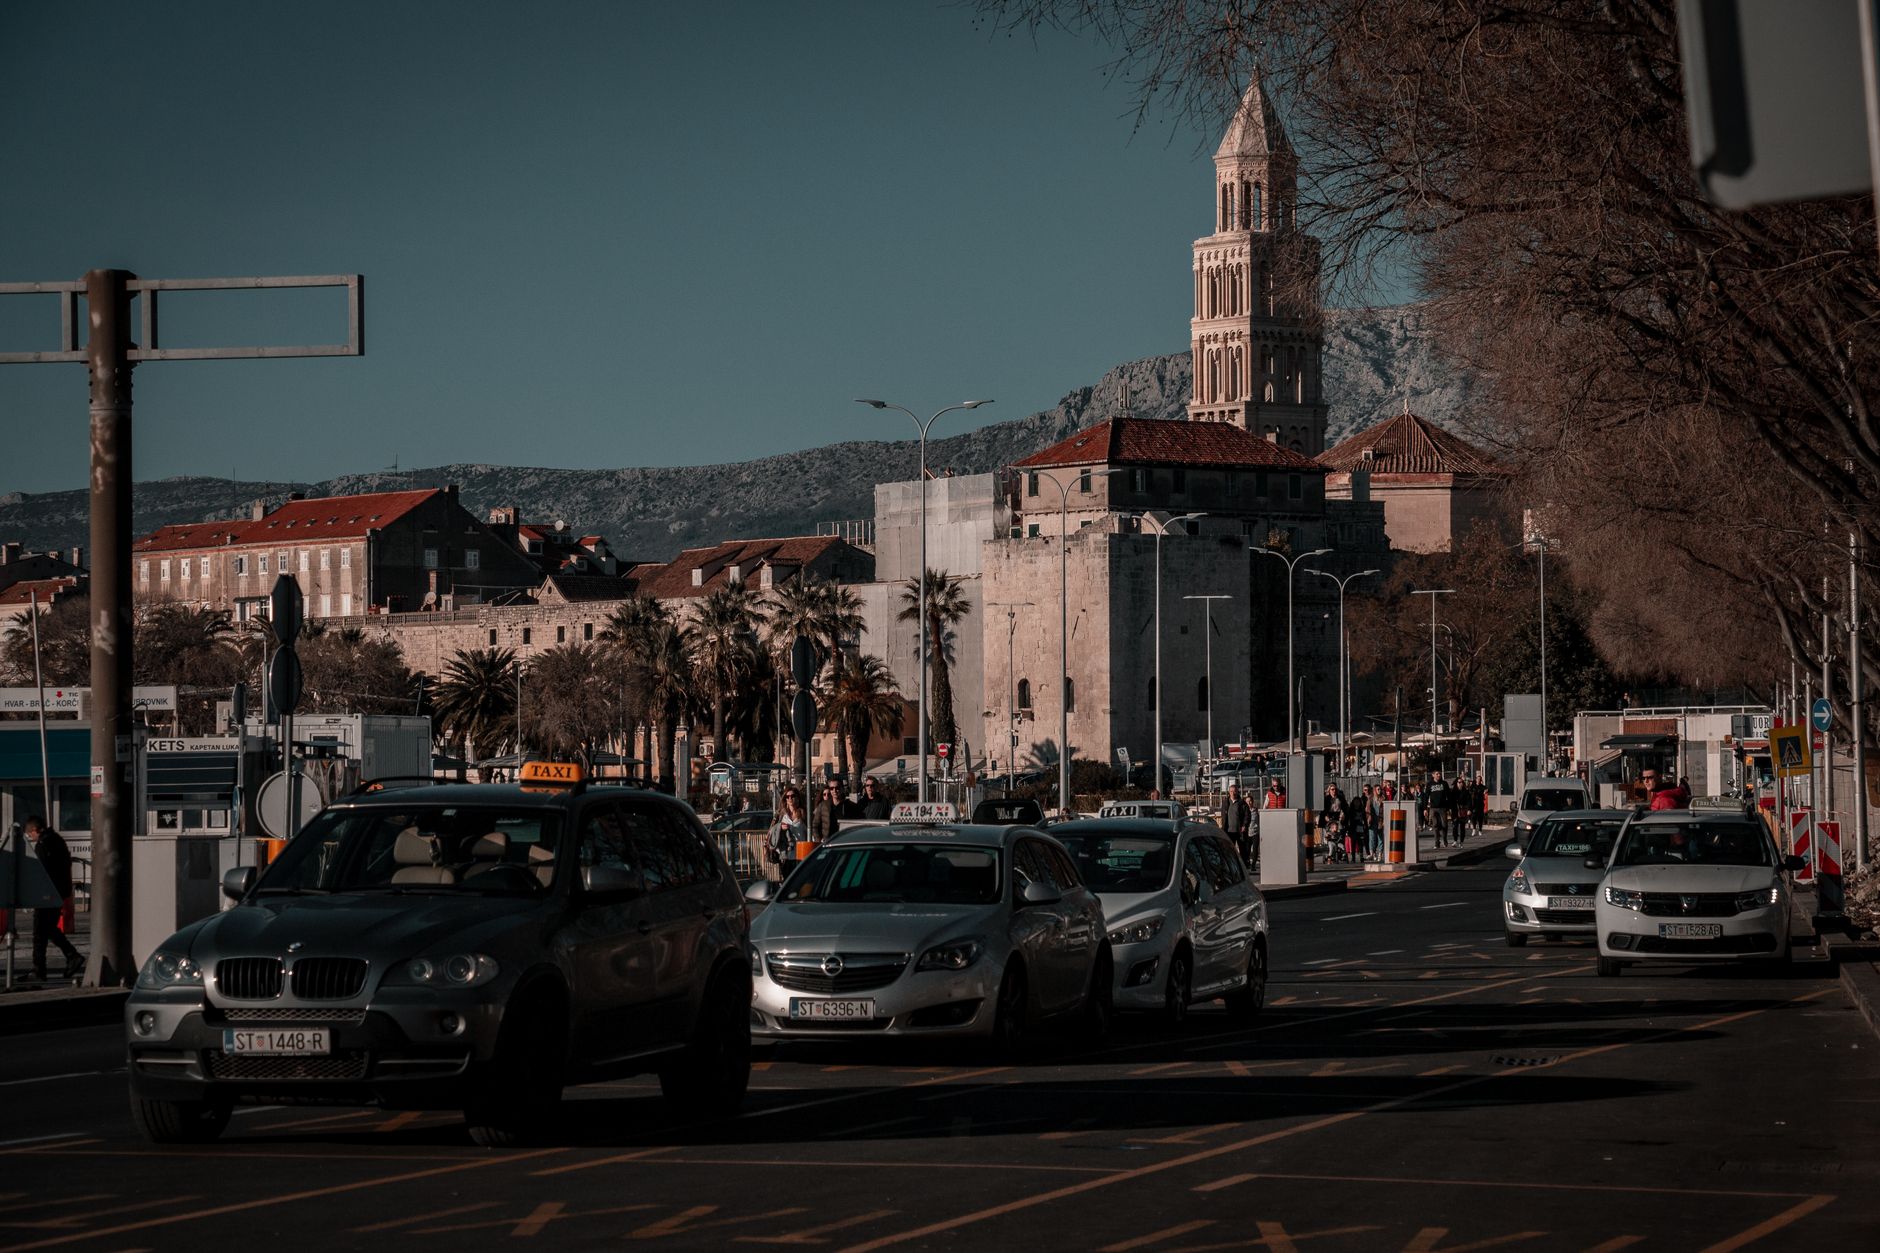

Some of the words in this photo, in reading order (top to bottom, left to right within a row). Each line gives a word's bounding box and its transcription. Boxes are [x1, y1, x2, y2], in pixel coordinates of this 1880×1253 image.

[4, 700, 24, 708] HVAR
[30, 699, 50, 708] BRČ
[149, 740, 185, 751] KETS
[531, 765, 572, 778] TAXI
[899, 806, 912, 817] TA
[914, 805, 932, 817] 194
[935, 806, 949, 817] XI
[1103, 806, 1134, 817] TAXI
[1552, 898, 1562, 908] ST
[1667, 925, 1678, 936] ST
[799, 1001, 815, 1016] ST
[822, 1001, 868, 1016] 6396-N
[235, 1032, 255, 1050] ST
[268, 1032, 323, 1051] 1448-R
